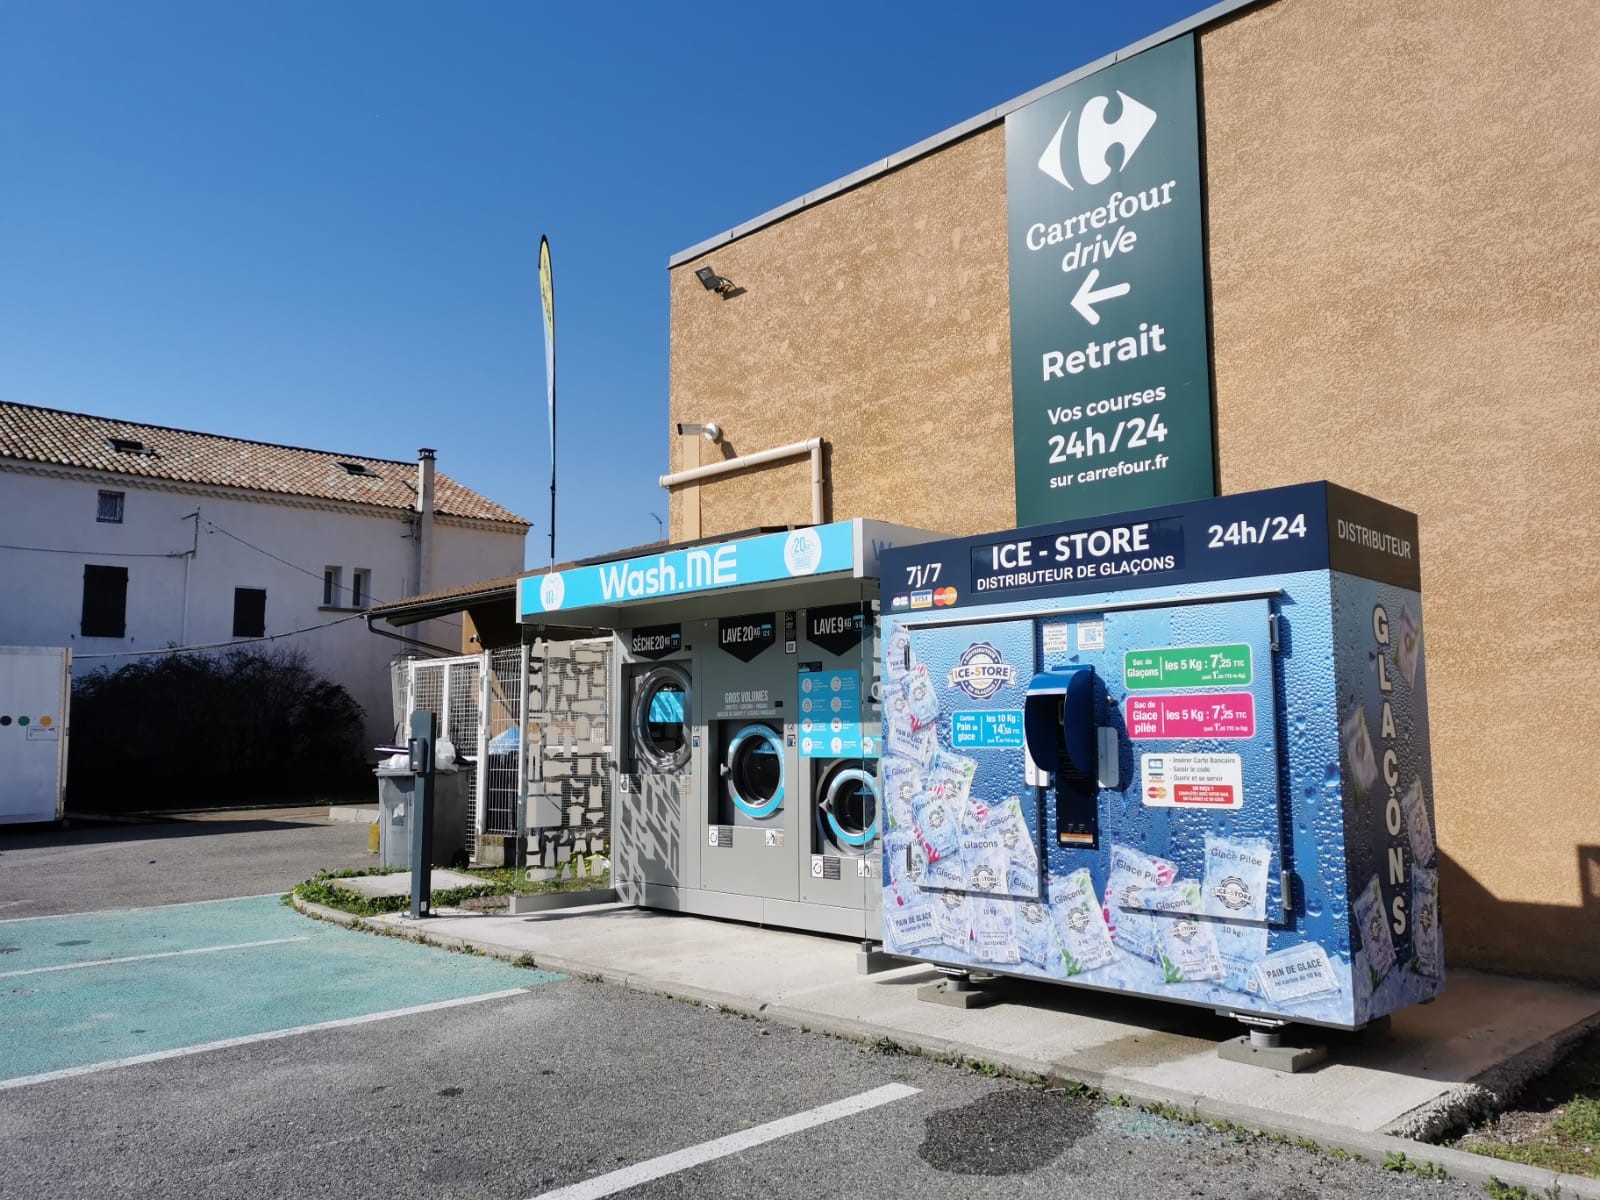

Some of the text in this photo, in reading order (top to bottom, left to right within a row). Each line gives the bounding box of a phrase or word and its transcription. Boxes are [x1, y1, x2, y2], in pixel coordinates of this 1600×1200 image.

[1026, 180, 1177, 252] Carrefour
[1061, 225, 1137, 273] drive
[1042, 323, 1167, 382] Retrait
[1047, 385, 1168, 426] Vos courses
[1048, 413, 1169, 464] 24h/24
[1049, 454, 1170, 490] sur carrefour.fr
[1208, 513, 1308, 549] 24h/24
[1337, 518, 1412, 560] DISTRIBUTEUR
[992, 541, 1031, 571] ICE
[1055, 524, 1150, 562] STORE
[906, 562, 942, 588] 7j/7
[977, 556, 1175, 592] DISTRIBUTEUR DE GLAÇONS
[722, 627, 742, 643] LAVE
[743, 625, 754, 641] 20
[814, 617, 837, 636] LAVE
[837, 616, 844, 633] 9
[632, 635, 655, 652] SÈCHE
[655, 635, 664, 650] 20
[954, 666, 1009, 680] ICE-STORE
[1127, 668, 1159, 679] Glaçons
[1165, 660, 1178, 670] les
[1181, 660, 1187, 669] 5
[1189, 659, 1202, 671] Kg
[741, 690, 768, 703] VOLUMES
[1147, 700, 1155, 708] de
[998, 714, 1005, 722] 10
[1007, 714, 1016, 723] Kg
[1133, 710, 1157, 720] Glace
[1166, 709, 1180, 720] les
[1182, 709, 1188, 720] 5
[1191, 709, 1204, 721] Kg
[957, 723, 972, 732] Pain
[1134, 723, 1157, 734] pilée
[958, 732, 976, 742] glace
[1372, 606, 1407, 936] GLAÇONS
[1211, 848, 1237, 861] Glace
[1116, 859, 1142, 876] Glace
[1266, 958, 1323, 979] PAIN DE GLACE
